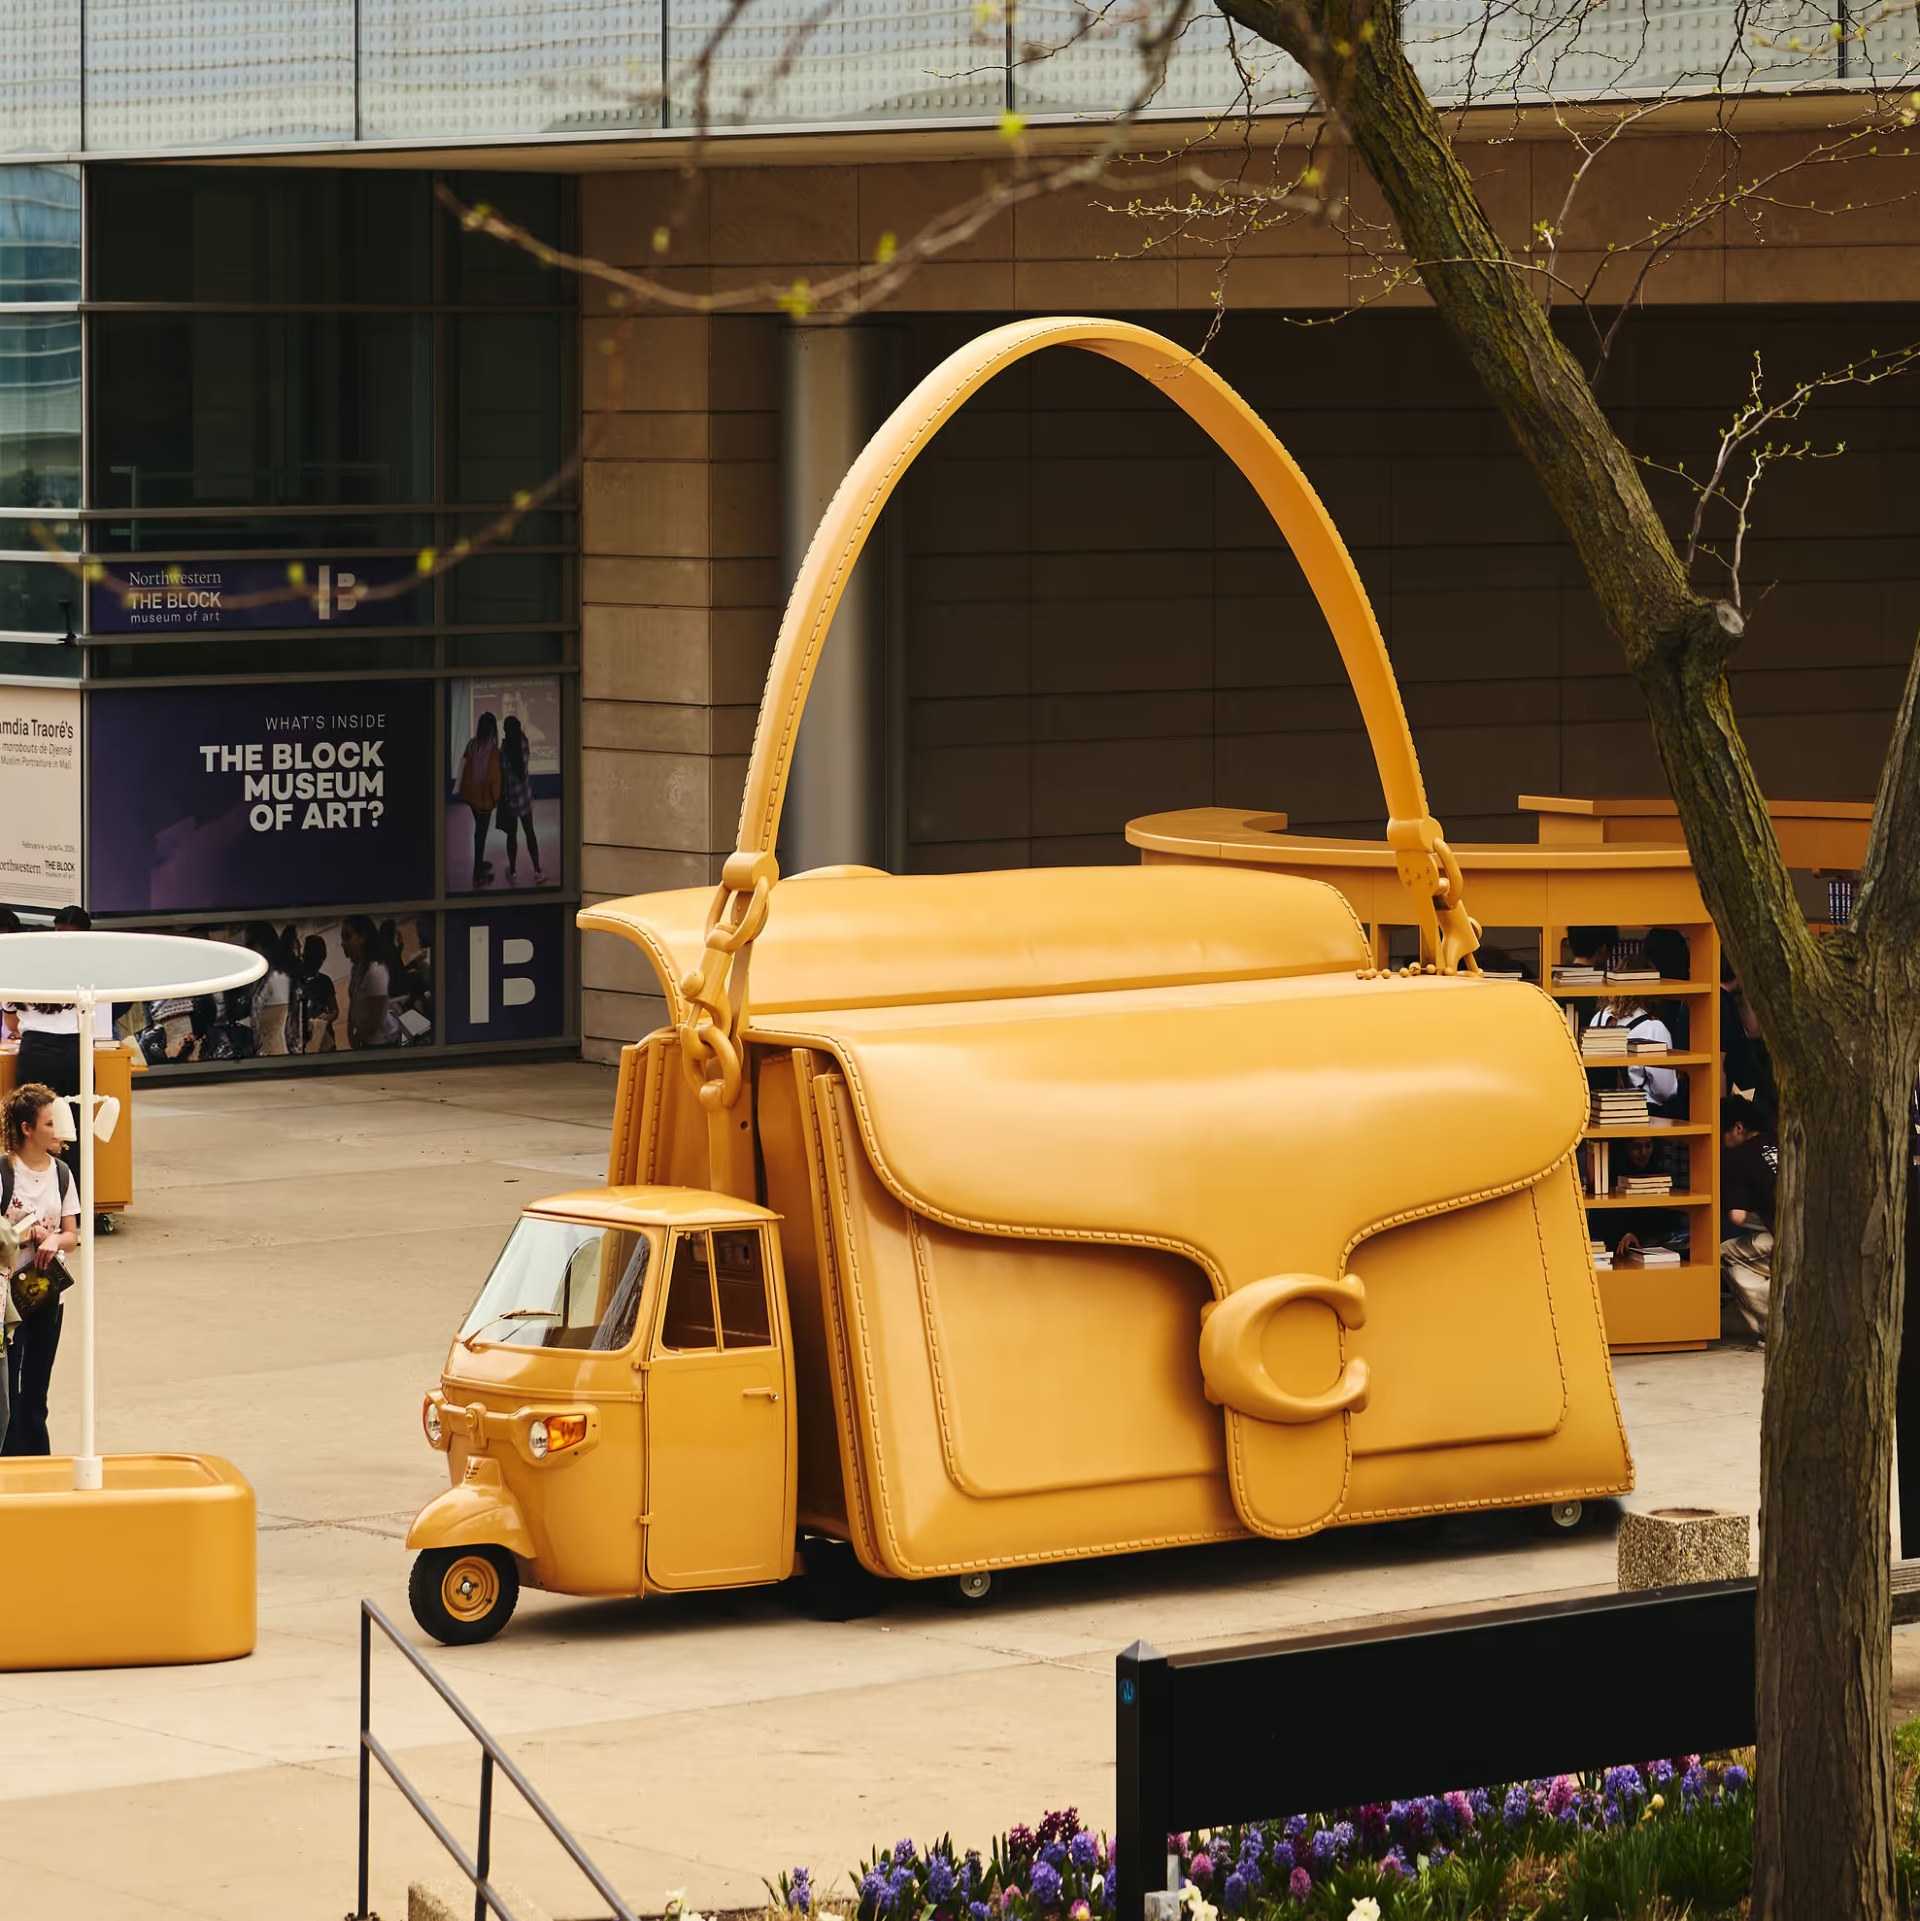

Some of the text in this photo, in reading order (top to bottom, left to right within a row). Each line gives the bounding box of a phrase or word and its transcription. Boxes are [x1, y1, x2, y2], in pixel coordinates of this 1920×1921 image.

[129, 571, 222, 586] Northwestern
[130, 591, 222, 610] THE BLOCK
[131, 611, 221, 624] museum of art
[0, 718, 74, 739] mdia Traoré's
[265, 713, 387, 731] WHAT'S INSIDE
[39, 742, 47, 755] de
[199, 740, 385, 773] THE BLOCK
[244, 771, 384, 802] MUSEUM
[249, 800, 385, 833] OF ART?
[44, 860, 56, 871] THE
[56, 861, 75, 872] BLOCK
